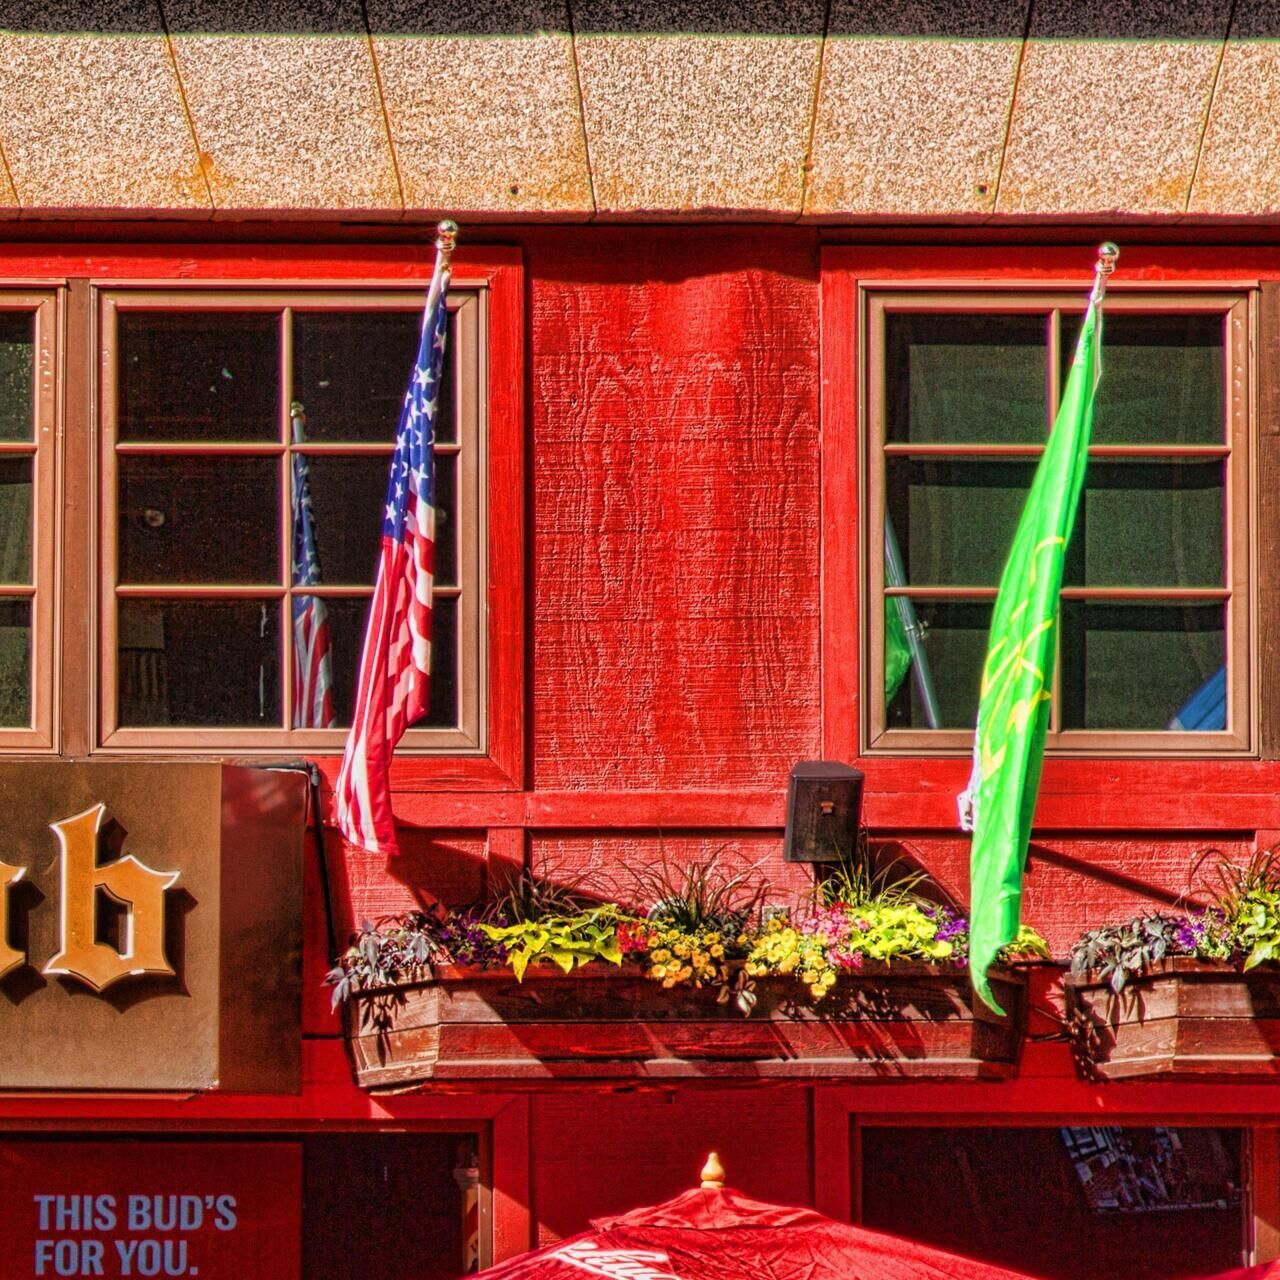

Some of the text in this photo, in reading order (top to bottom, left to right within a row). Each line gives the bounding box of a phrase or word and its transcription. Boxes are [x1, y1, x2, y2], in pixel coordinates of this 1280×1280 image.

[33, 1194, 238, 1231] THIS BUD'S
[34, 1239, 199, 1276] FOR YOU.
